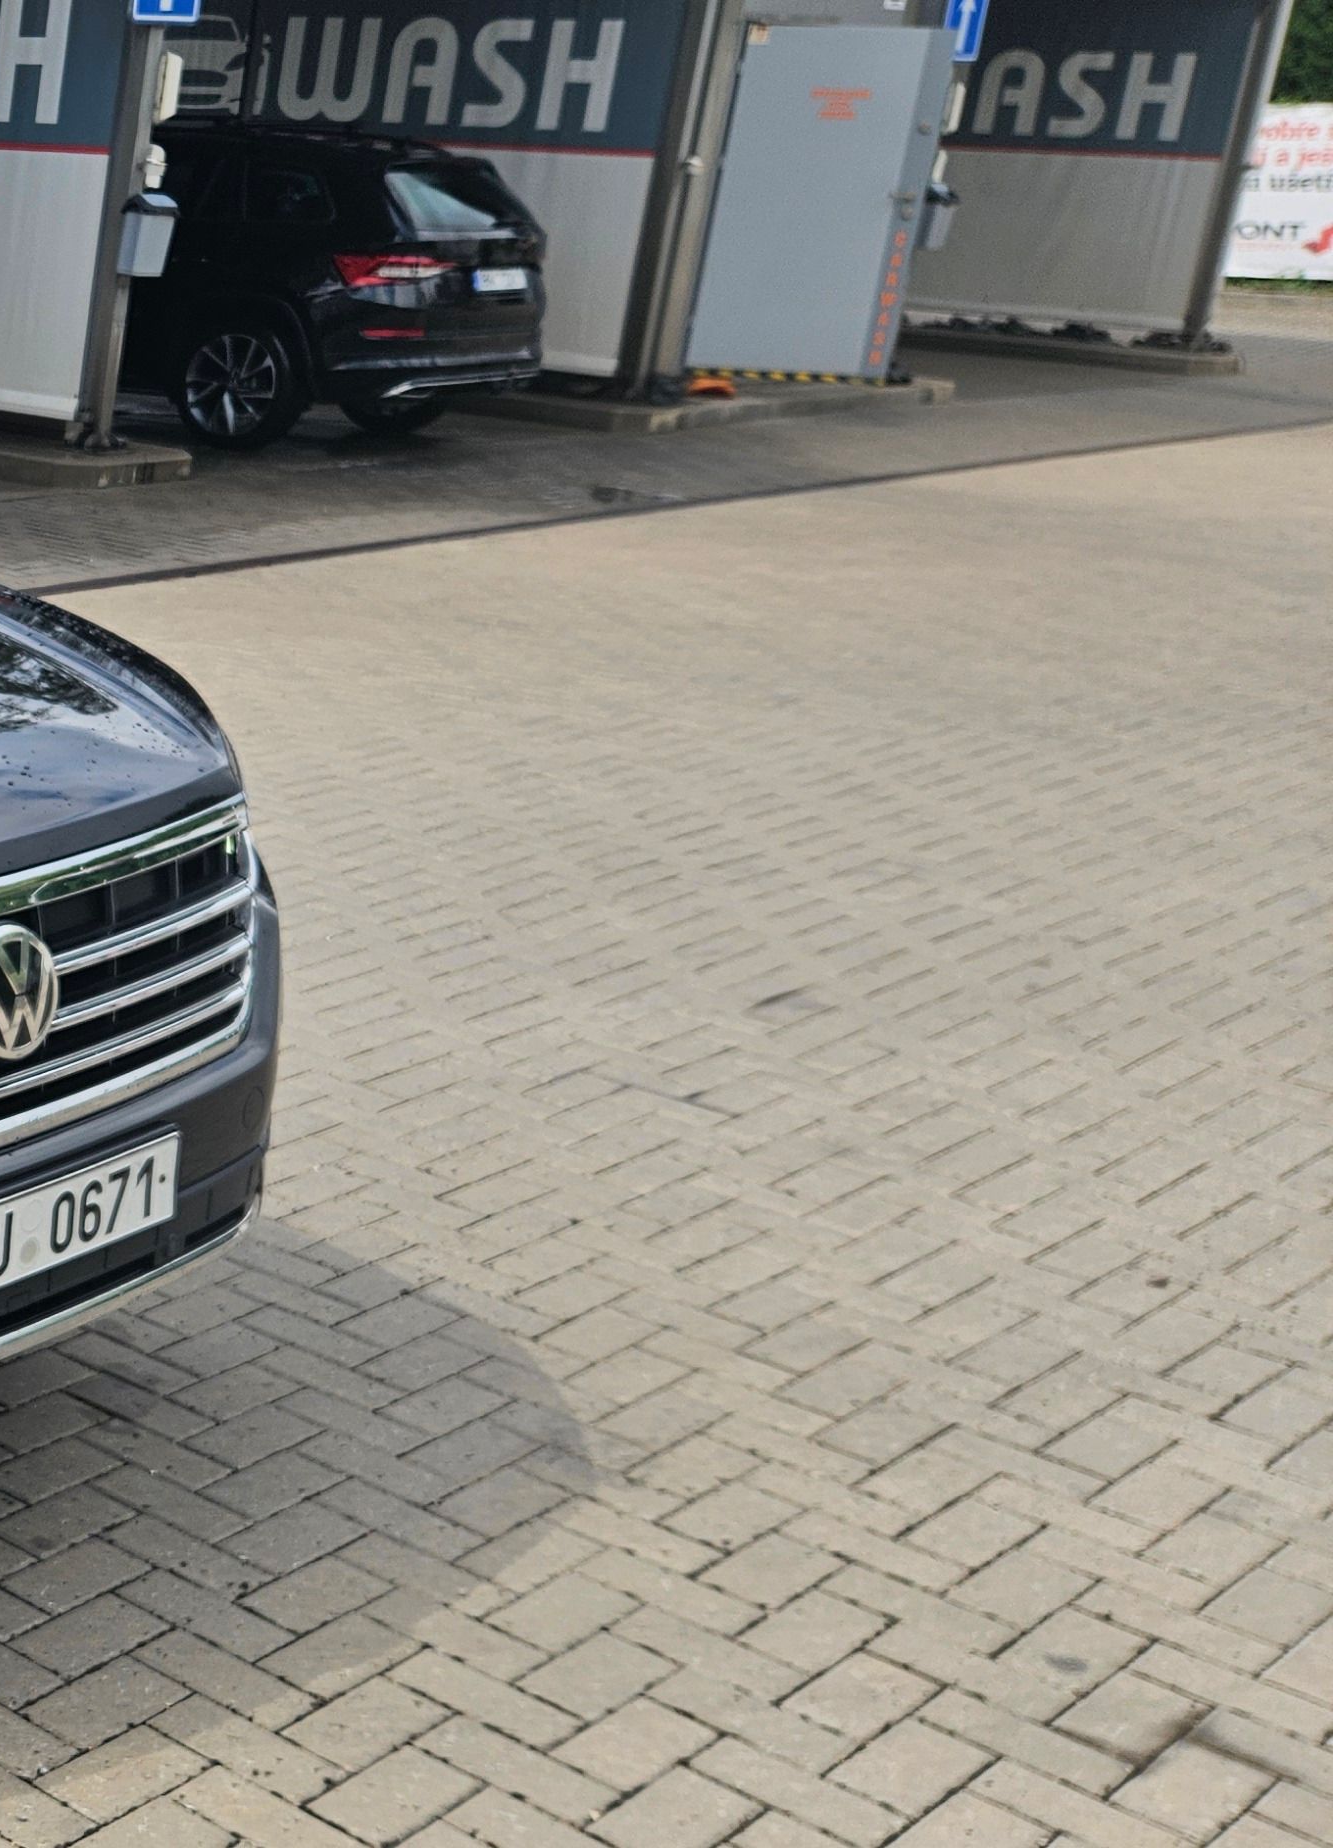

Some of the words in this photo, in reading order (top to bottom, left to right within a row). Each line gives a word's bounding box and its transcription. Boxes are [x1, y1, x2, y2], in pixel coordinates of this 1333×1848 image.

[277, 15, 625, 132] WASH
[971, 49, 1198, 142] ASH
[1236, 221, 1307, 241] ONT
[50, 1155, 155, 1254] 0671
